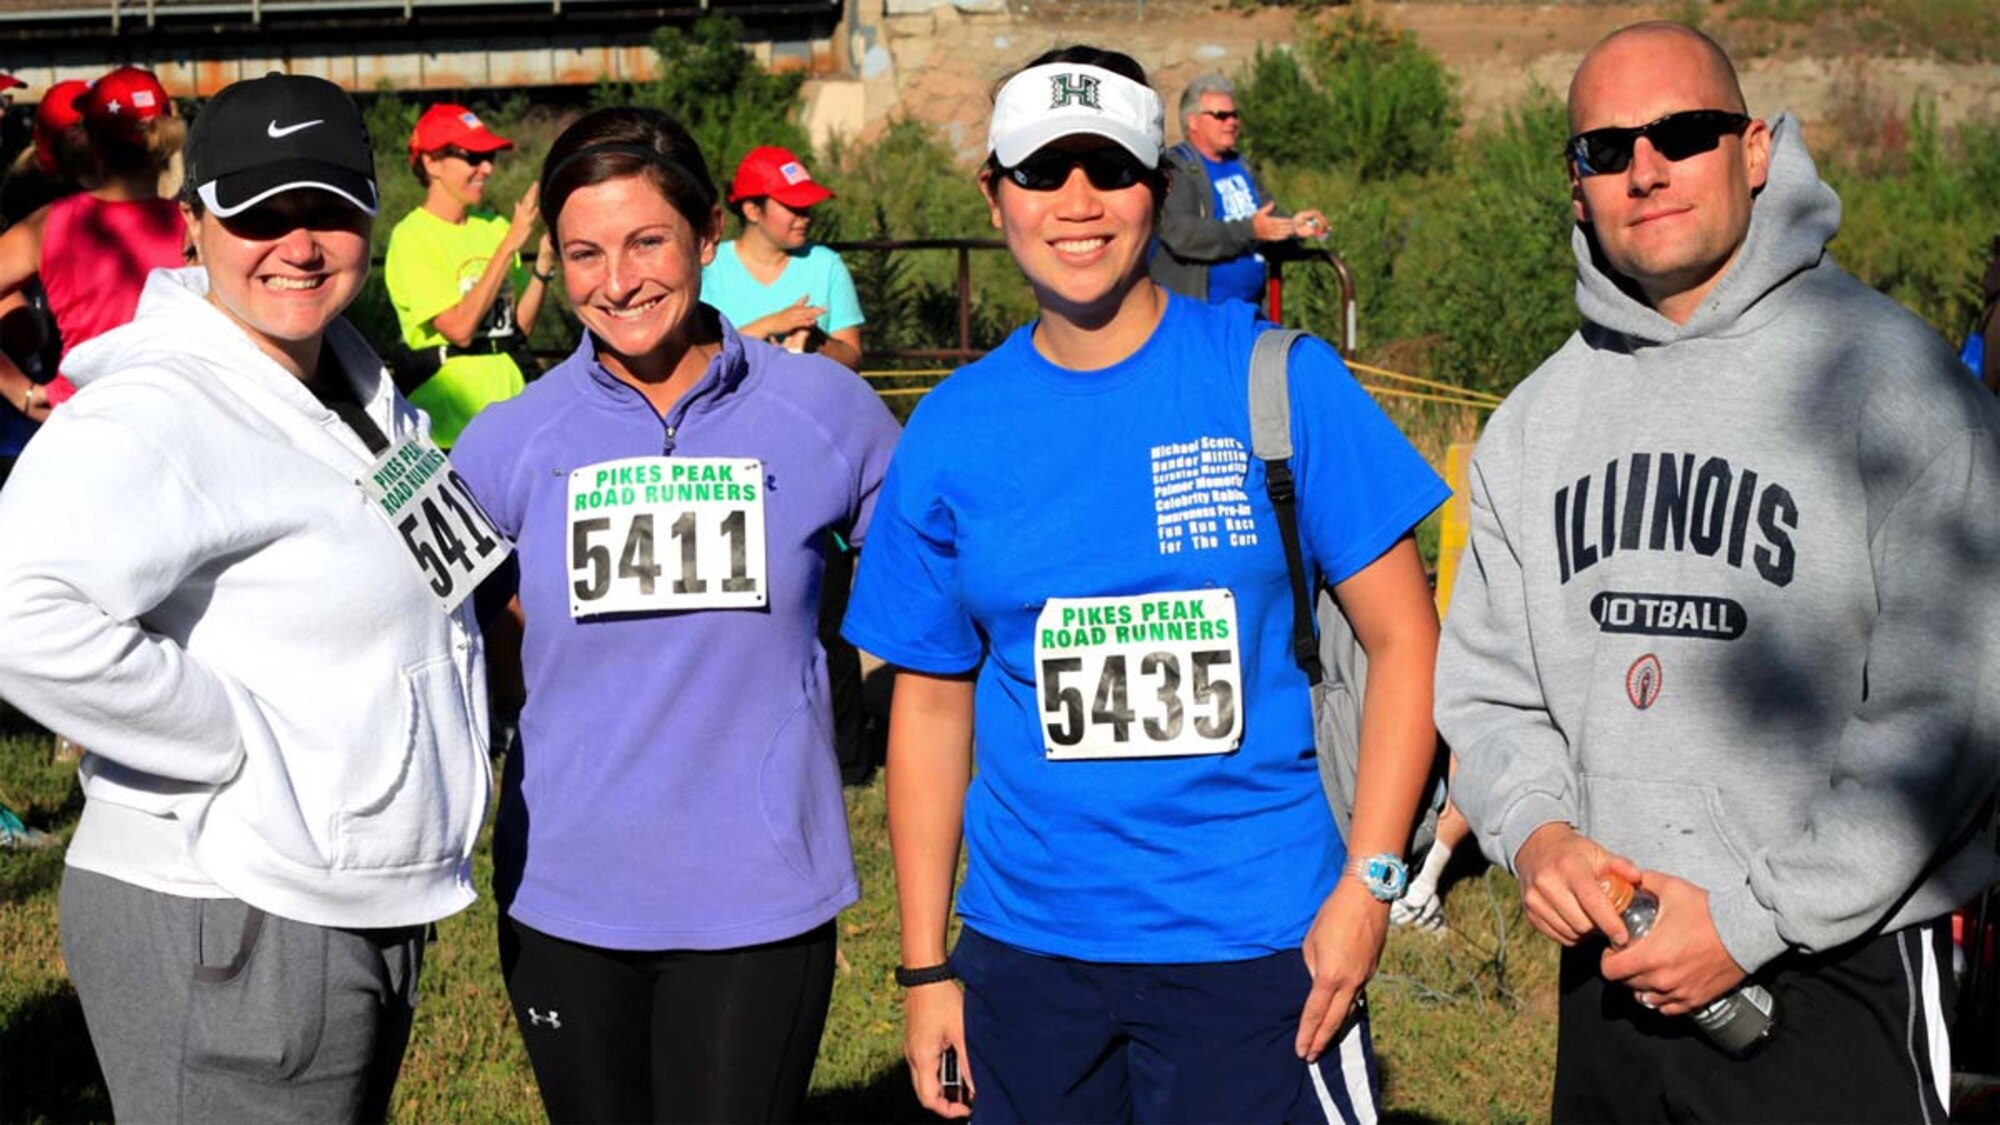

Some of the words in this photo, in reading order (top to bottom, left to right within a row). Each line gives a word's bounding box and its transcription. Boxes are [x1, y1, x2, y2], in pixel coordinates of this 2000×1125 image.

[1048, 73, 1103, 110] H
[1151, 439, 1199, 459] Michael
[1152, 456, 1199, 474] Dunder
[1201, 450, 1247, 463] Mifflin
[373, 457, 406, 491] PIKES
[596, 465, 662, 488] PIKES
[672, 465, 734, 482] PEAK
[1153, 469, 1199, 485] Scranton
[380, 480, 413, 517] ROAD
[575, 487, 636, 511] ROAD
[645, 484, 756, 503] RUNNERS
[1154, 481, 1193, 498] Palmer
[1155, 492, 1209, 512] Celebrity
[1157, 506, 1216, 526] Awareness
[398, 470, 506, 598] 5410
[1158, 526, 1182, 540] Fun
[1189, 521, 1216, 534] Run
[1159, 541, 1181, 555] For
[1191, 536, 1218, 550] The
[1230, 533, 1257, 546] Cure
[573, 510, 757, 601] 5411
[1063, 605, 1132, 627] PIKES
[1142, 600, 1206, 621] PEAK
[1600, 597, 1734, 633] OTBALL
[1041, 626, 1107, 649] ROAD
[1116, 619, 1229, 643] RUNNERS
[1042, 649, 1235, 746] 5435
